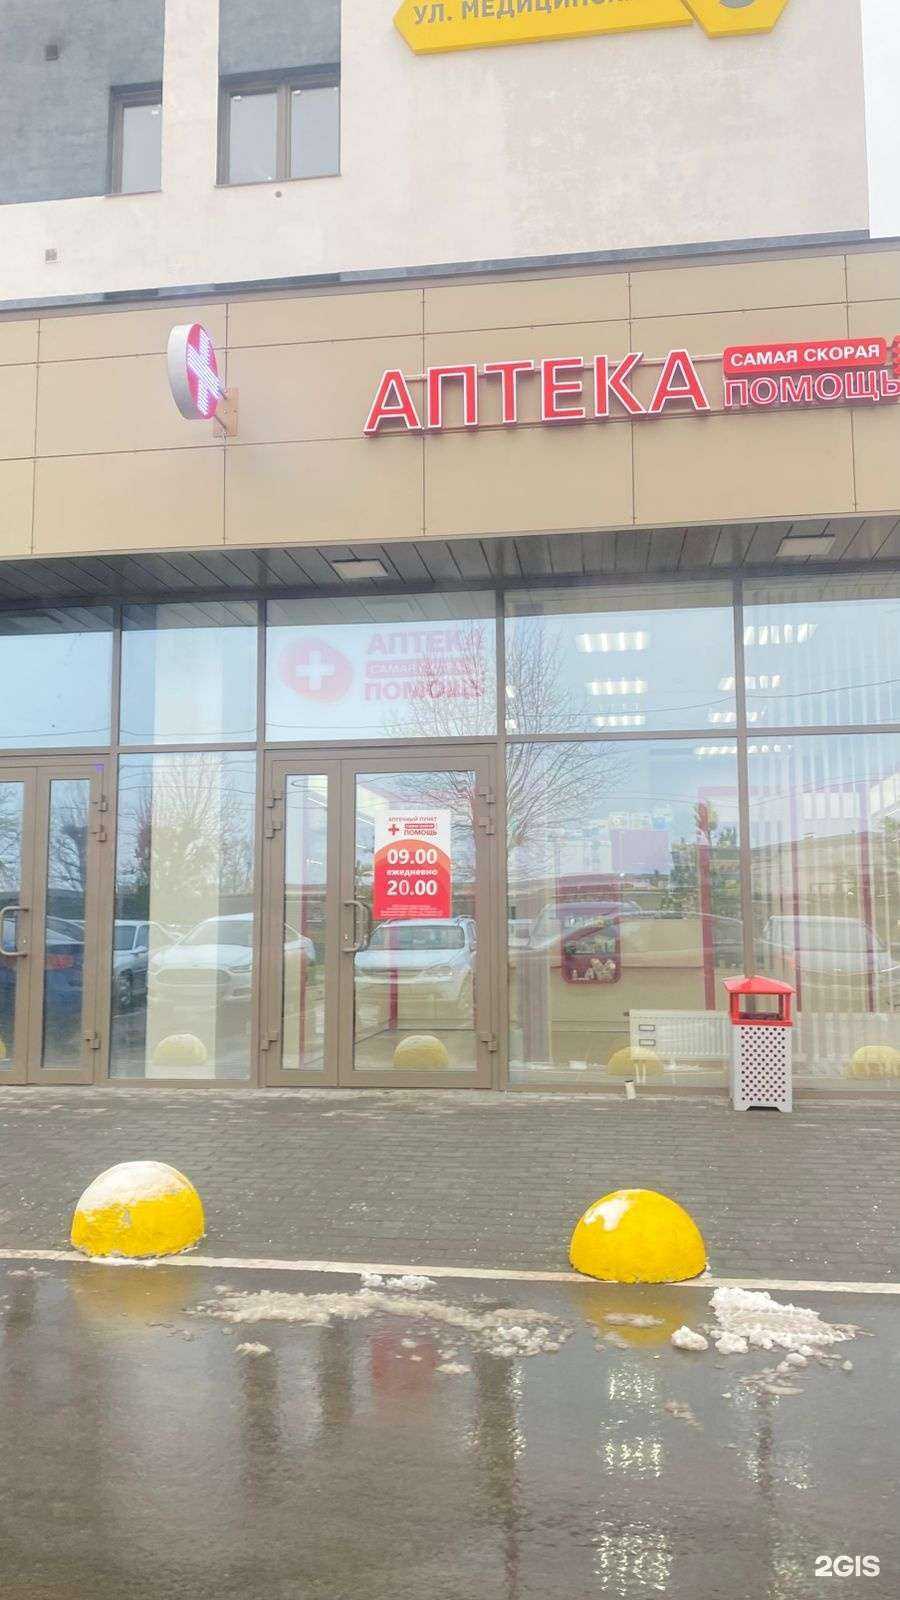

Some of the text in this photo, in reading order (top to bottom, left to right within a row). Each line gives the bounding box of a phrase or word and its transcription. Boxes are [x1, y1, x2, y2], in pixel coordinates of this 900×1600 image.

[414, 3, 452, 24] УЛ.
[730, 344, 880, 367] САМАЯ СКОРАЯ
[363, 349, 711, 434] АПТЕКА
[724, 369, 900, 406] ПОМОЩЬ
[387, 848, 438, 864] 09.00
[387, 880, 438, 896] 20.00
